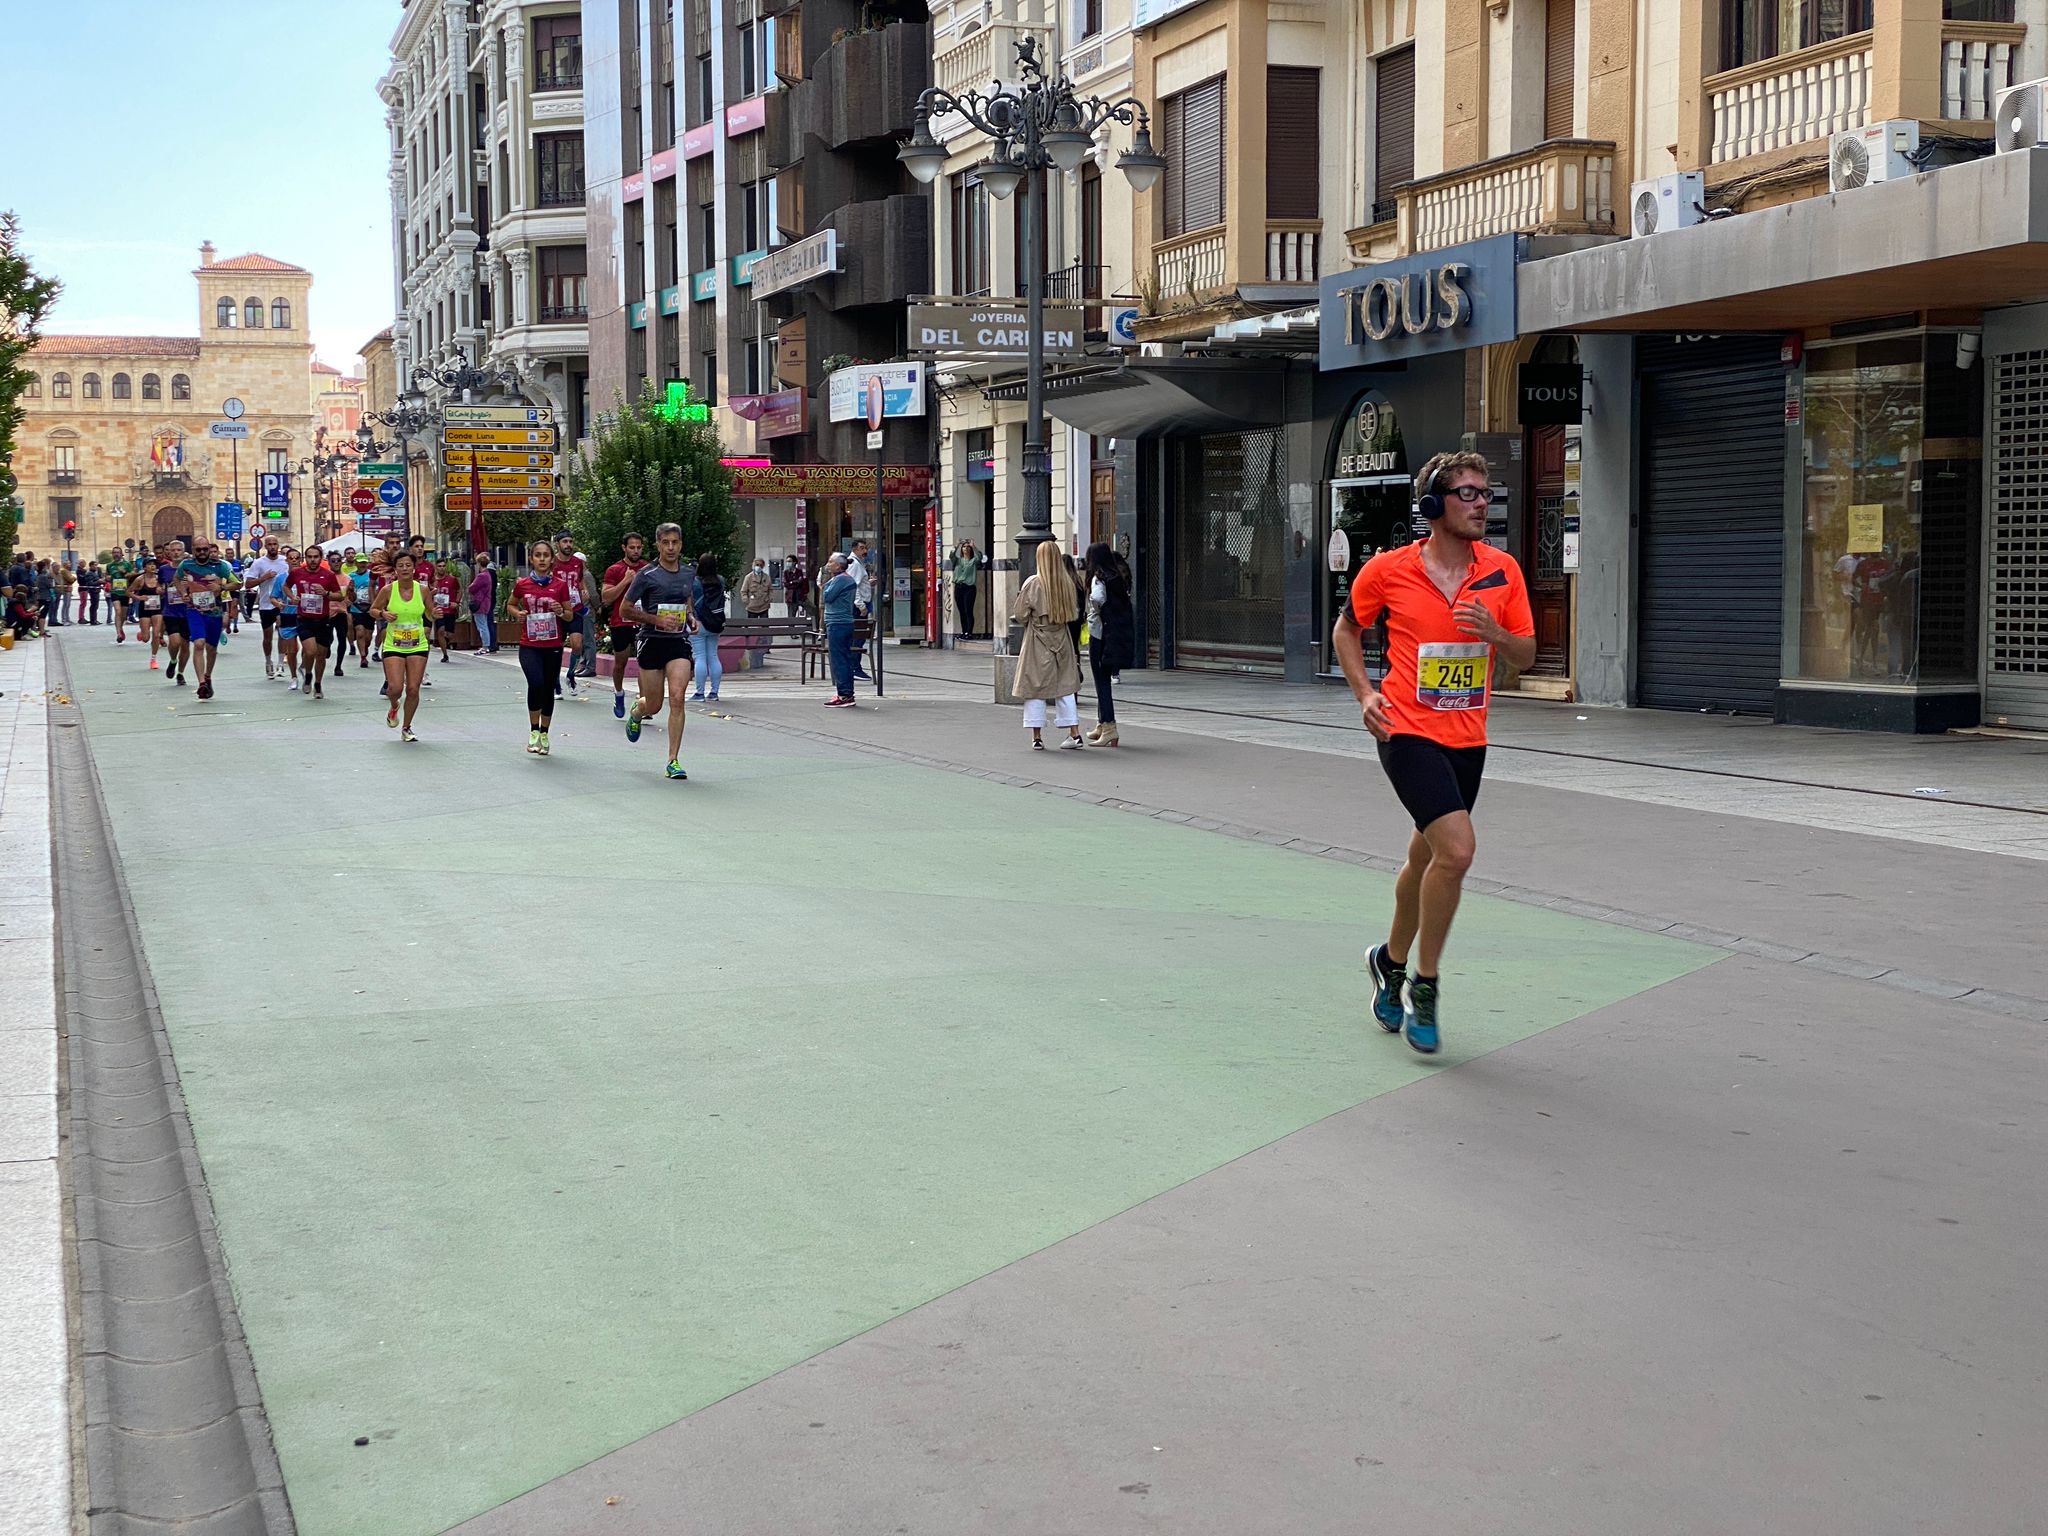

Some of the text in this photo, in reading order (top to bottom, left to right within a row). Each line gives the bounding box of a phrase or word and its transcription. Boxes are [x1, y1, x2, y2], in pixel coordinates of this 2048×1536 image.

[1337, 262, 1472, 346] TOUS
[970, 313, 1026, 324] JOYERIA
[921, 328, 1073, 347] DEL CAREN
[1524, 387, 1578, 401] TOUS
[528, 410, 536, 420] P
[1360, 413, 1375, 431] BE
[212, 423, 246, 434] Cámara
[481, 454, 500, 462] León
[1341, 451, 1397, 473] BE BEAUTY
[735, 467, 906, 478] ROYAL TANDOORI
[264, 475, 278, 496] P
[743, 479, 778, 487] INDIAN
[534, 621, 550, 632] 350
[1437, 665, 1474, 688] 249
